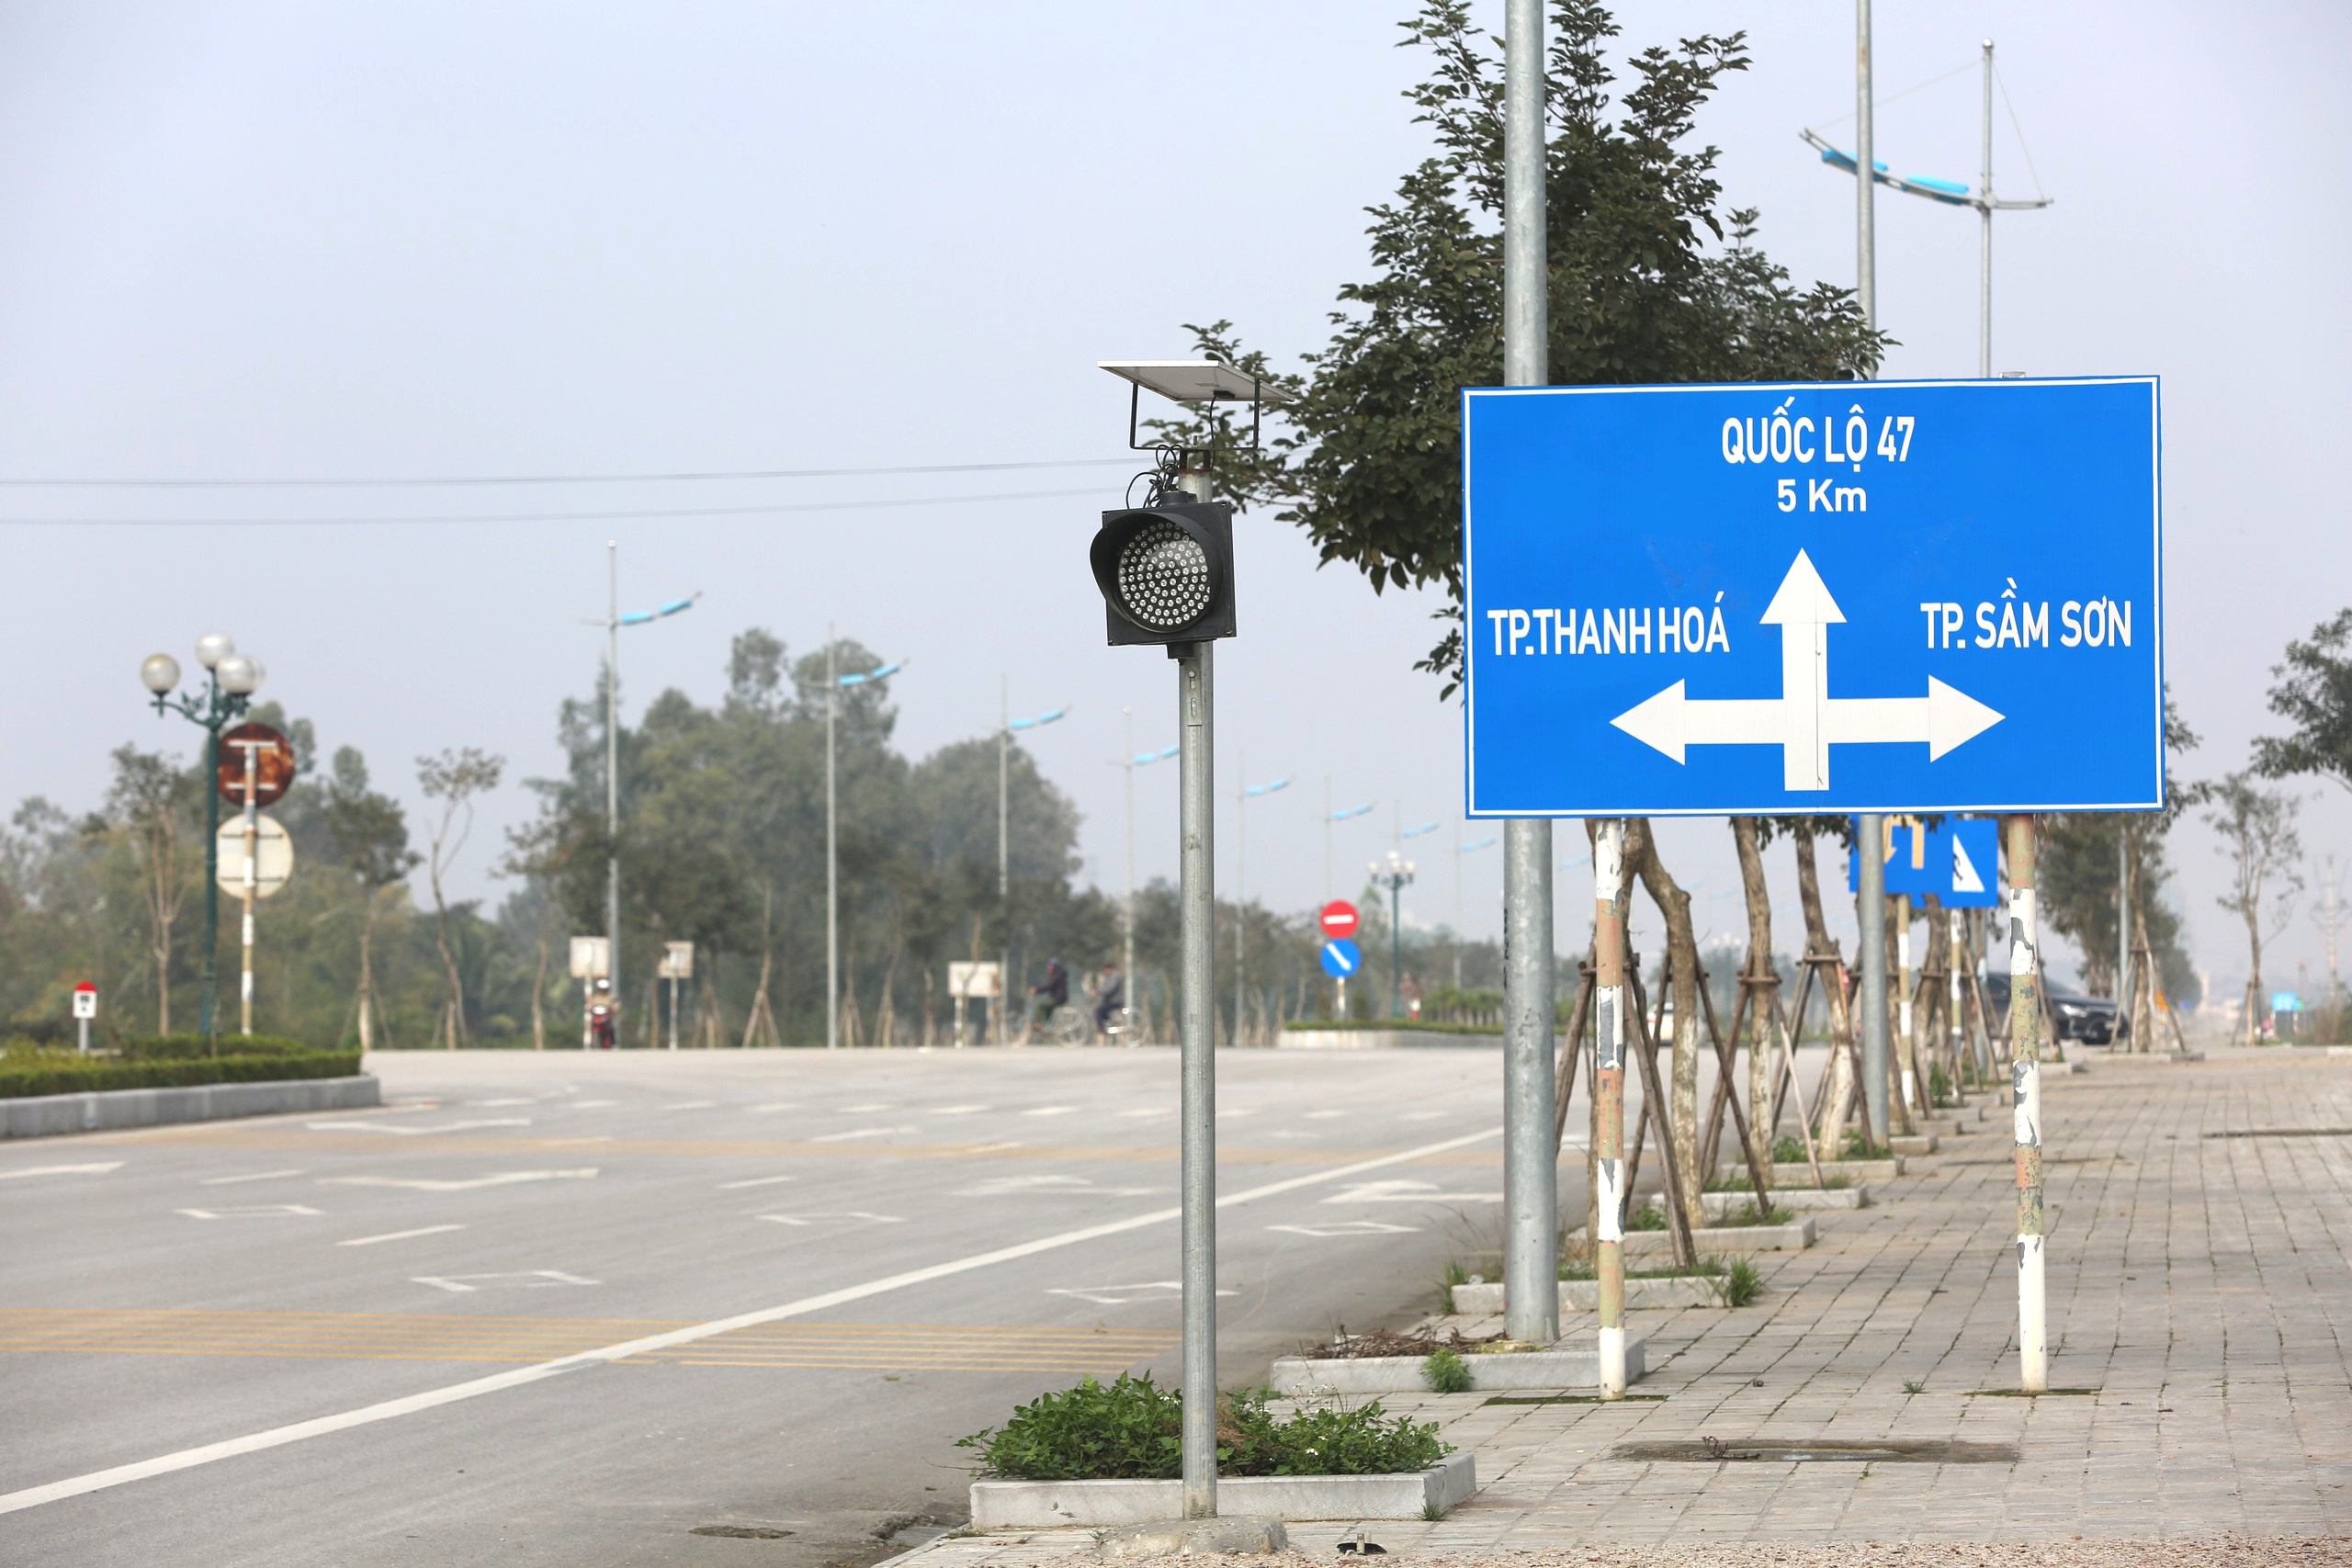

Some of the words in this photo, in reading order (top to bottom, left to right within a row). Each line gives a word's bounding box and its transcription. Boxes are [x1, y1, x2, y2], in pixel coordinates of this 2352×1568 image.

[1722, 397, 1815, 465] QUỐC
[1825, 403, 1868, 473] LỘ
[1876, 416, 1916, 462] 47
[1777, 479, 1797, 513] 5
[1808, 478, 1867, 513] Km
[1658, 591, 1731, 653] HOÁ
[1919, 602, 1966, 649] TP.
[1974, 577, 2049, 649] SẦM
[2060, 594, 2132, 648] SƠN
